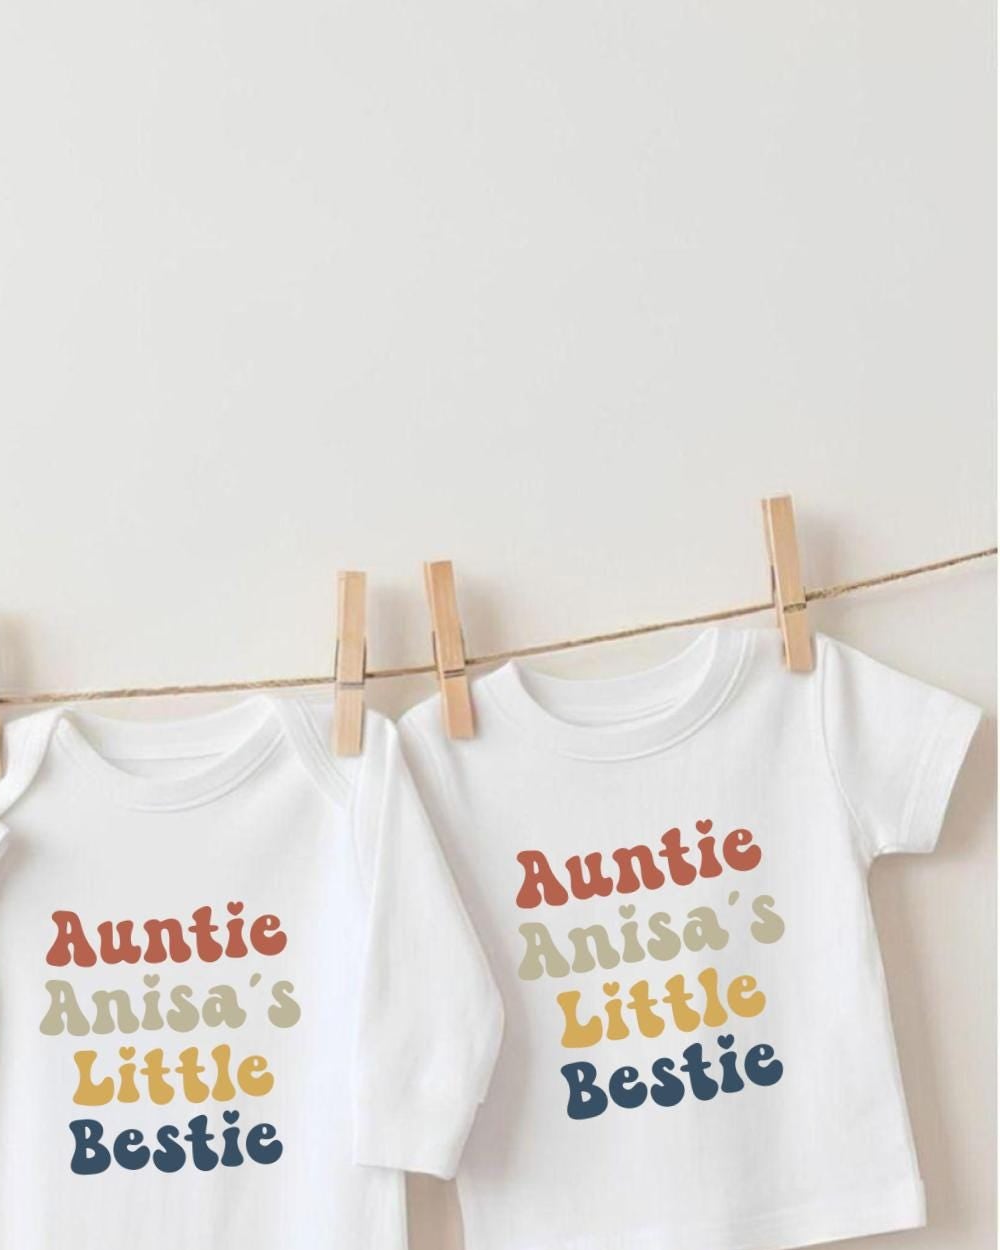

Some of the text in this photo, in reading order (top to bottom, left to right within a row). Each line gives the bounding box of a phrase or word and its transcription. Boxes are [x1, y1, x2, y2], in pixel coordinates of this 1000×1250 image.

[516, 819, 761, 909] Auntie
[46, 901, 287, 967] Auntie
[556, 967, 766, 1048] Little
[73, 1043, 274, 1106] Little
[560, 1033, 783, 1119] Bestie
[68, 1109, 283, 1174] Bestie
